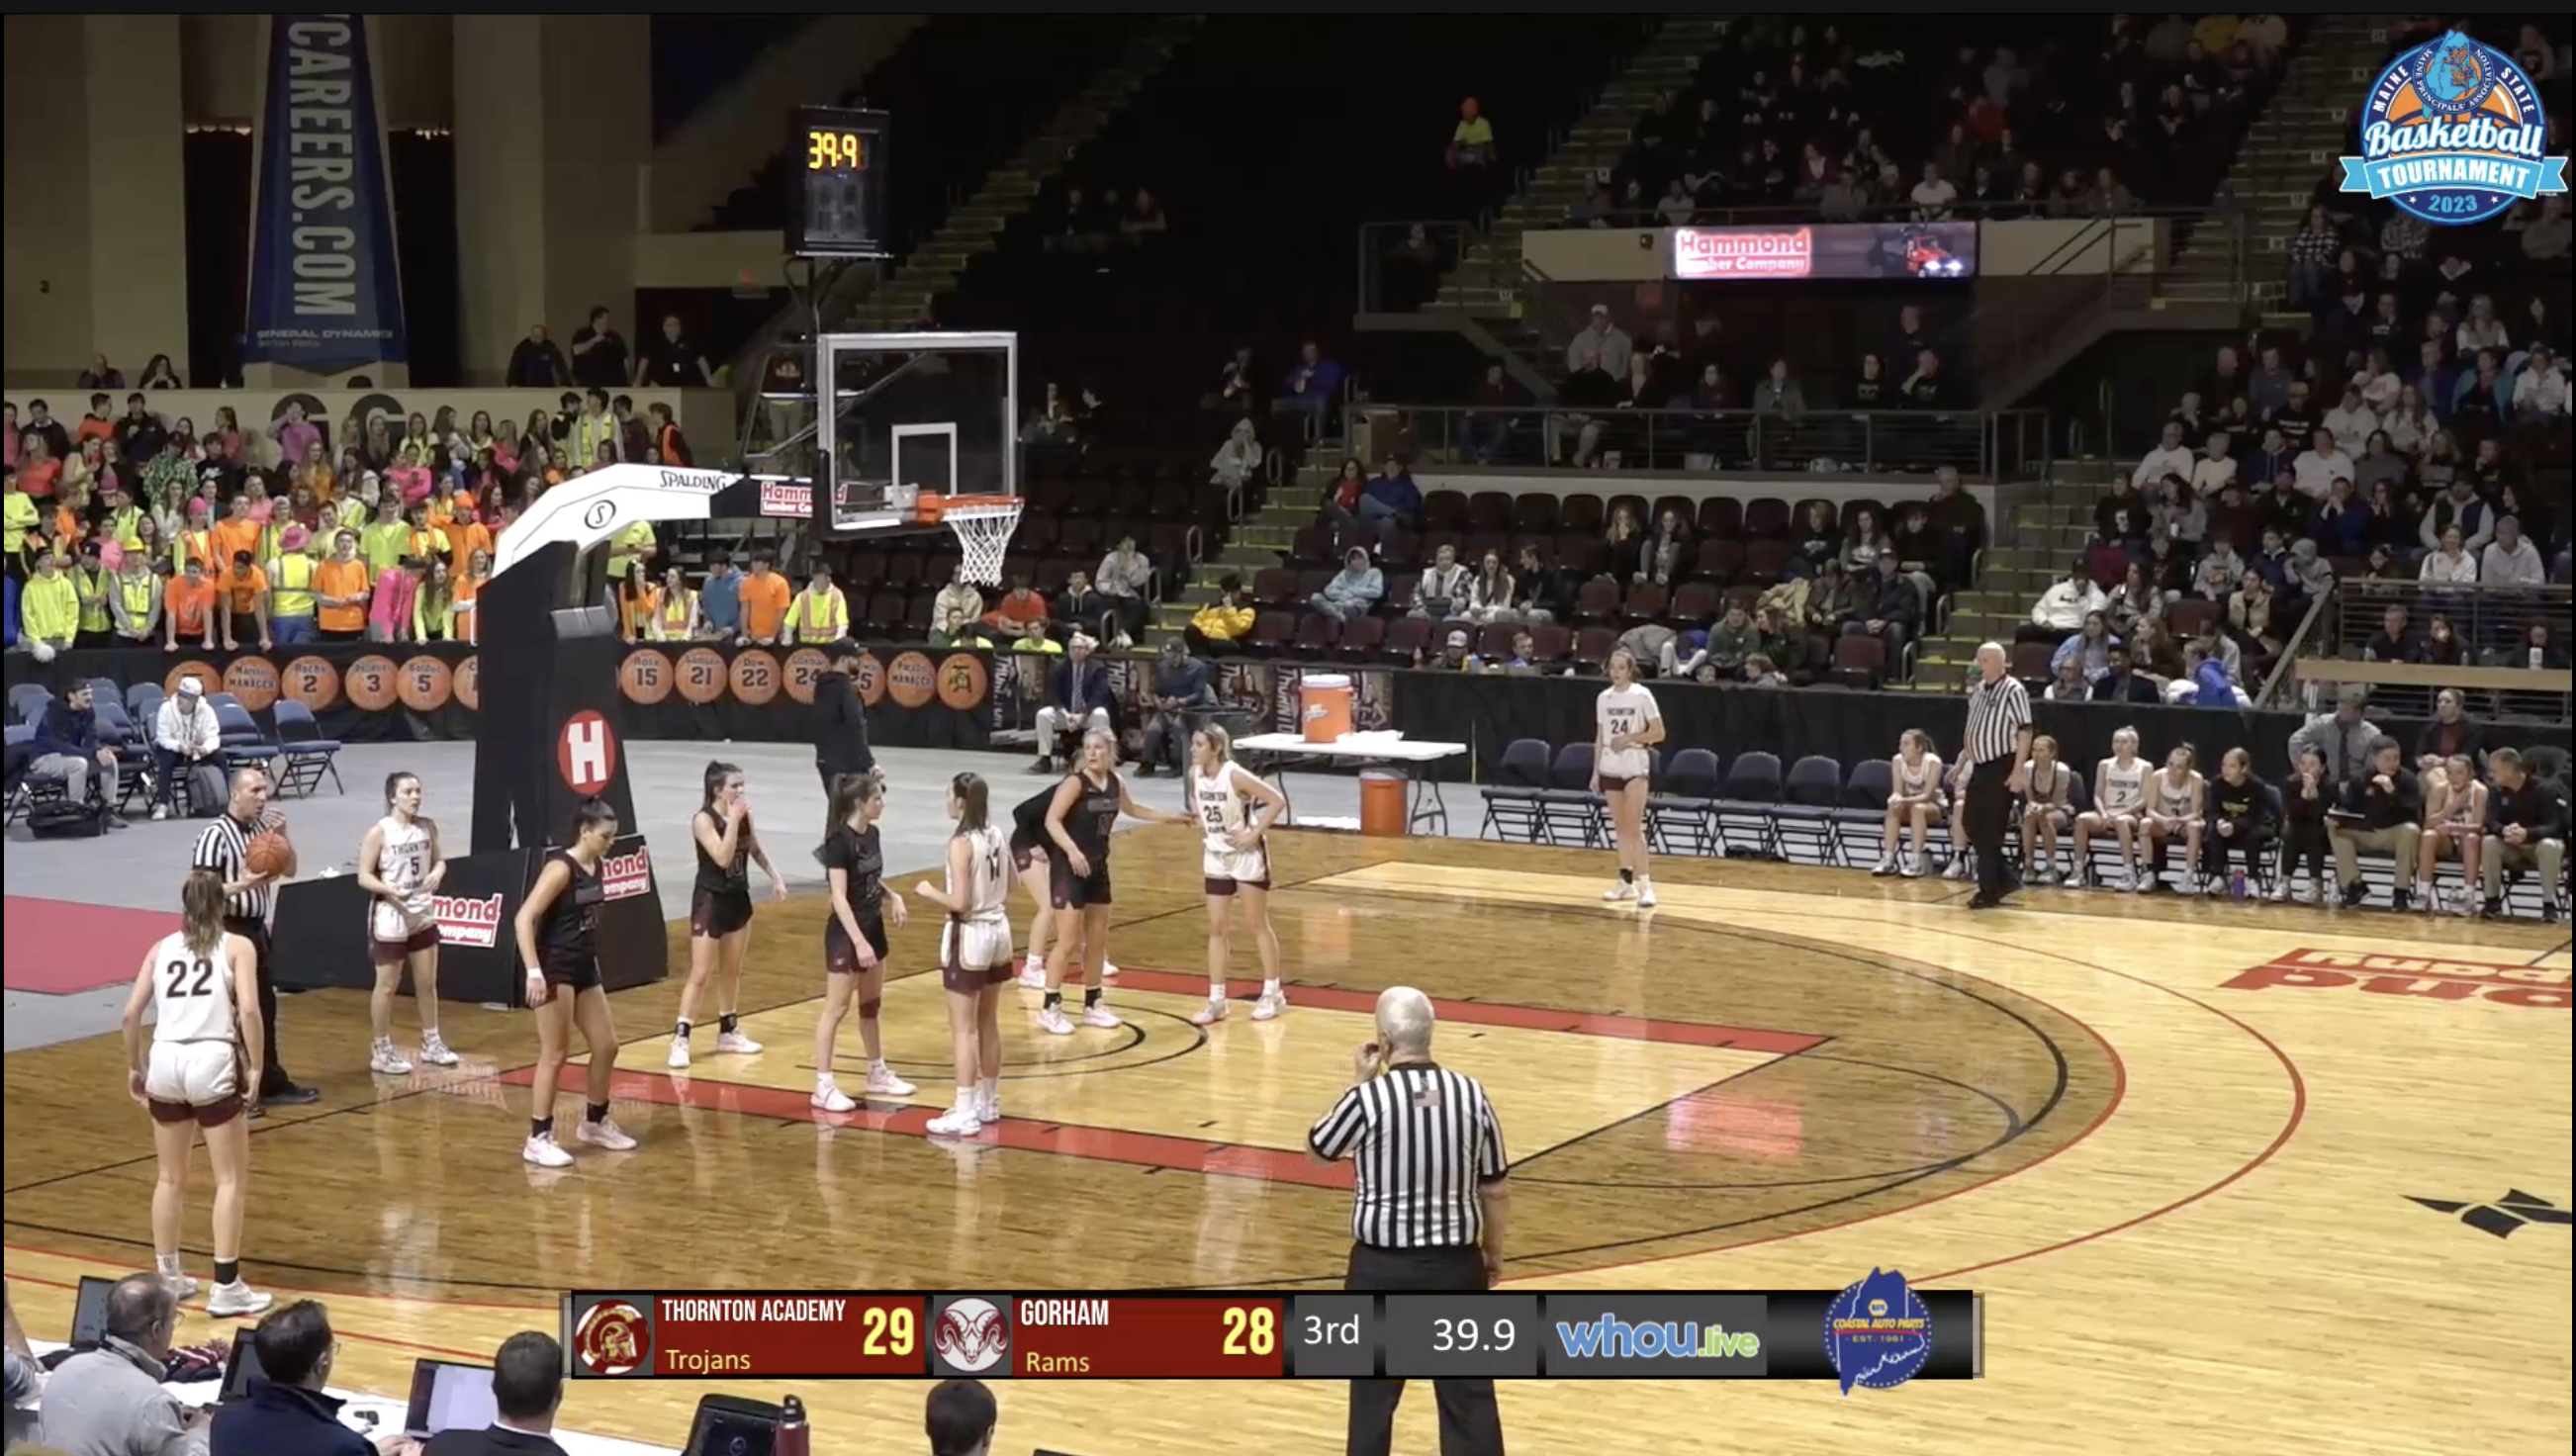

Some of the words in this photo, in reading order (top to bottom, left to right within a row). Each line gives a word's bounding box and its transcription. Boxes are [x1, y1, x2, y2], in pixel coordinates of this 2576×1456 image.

[809, 132, 857, 169] 39.9
[288, 14, 356, 315] CAREERS.COM
[1680, 228, 1809, 254] Hammond
[660, 470, 727, 492] SPALDING
[304, 675, 317, 693] 2
[367, 674, 381, 692] 3
[417, 675, 431, 692] 5
[636, 668, 658, 686] 15
[690, 667, 712, 685] 21
[742, 669, 769, 687] 22
[1610, 718, 1628, 734] 24
[567, 720, 606, 784] H
[2116, 791, 2126, 804] 2
[1203, 804, 1223, 823] 25
[411, 856, 420, 876] 5
[432, 894, 501, 922] mond
[166, 957, 214, 999] 22
